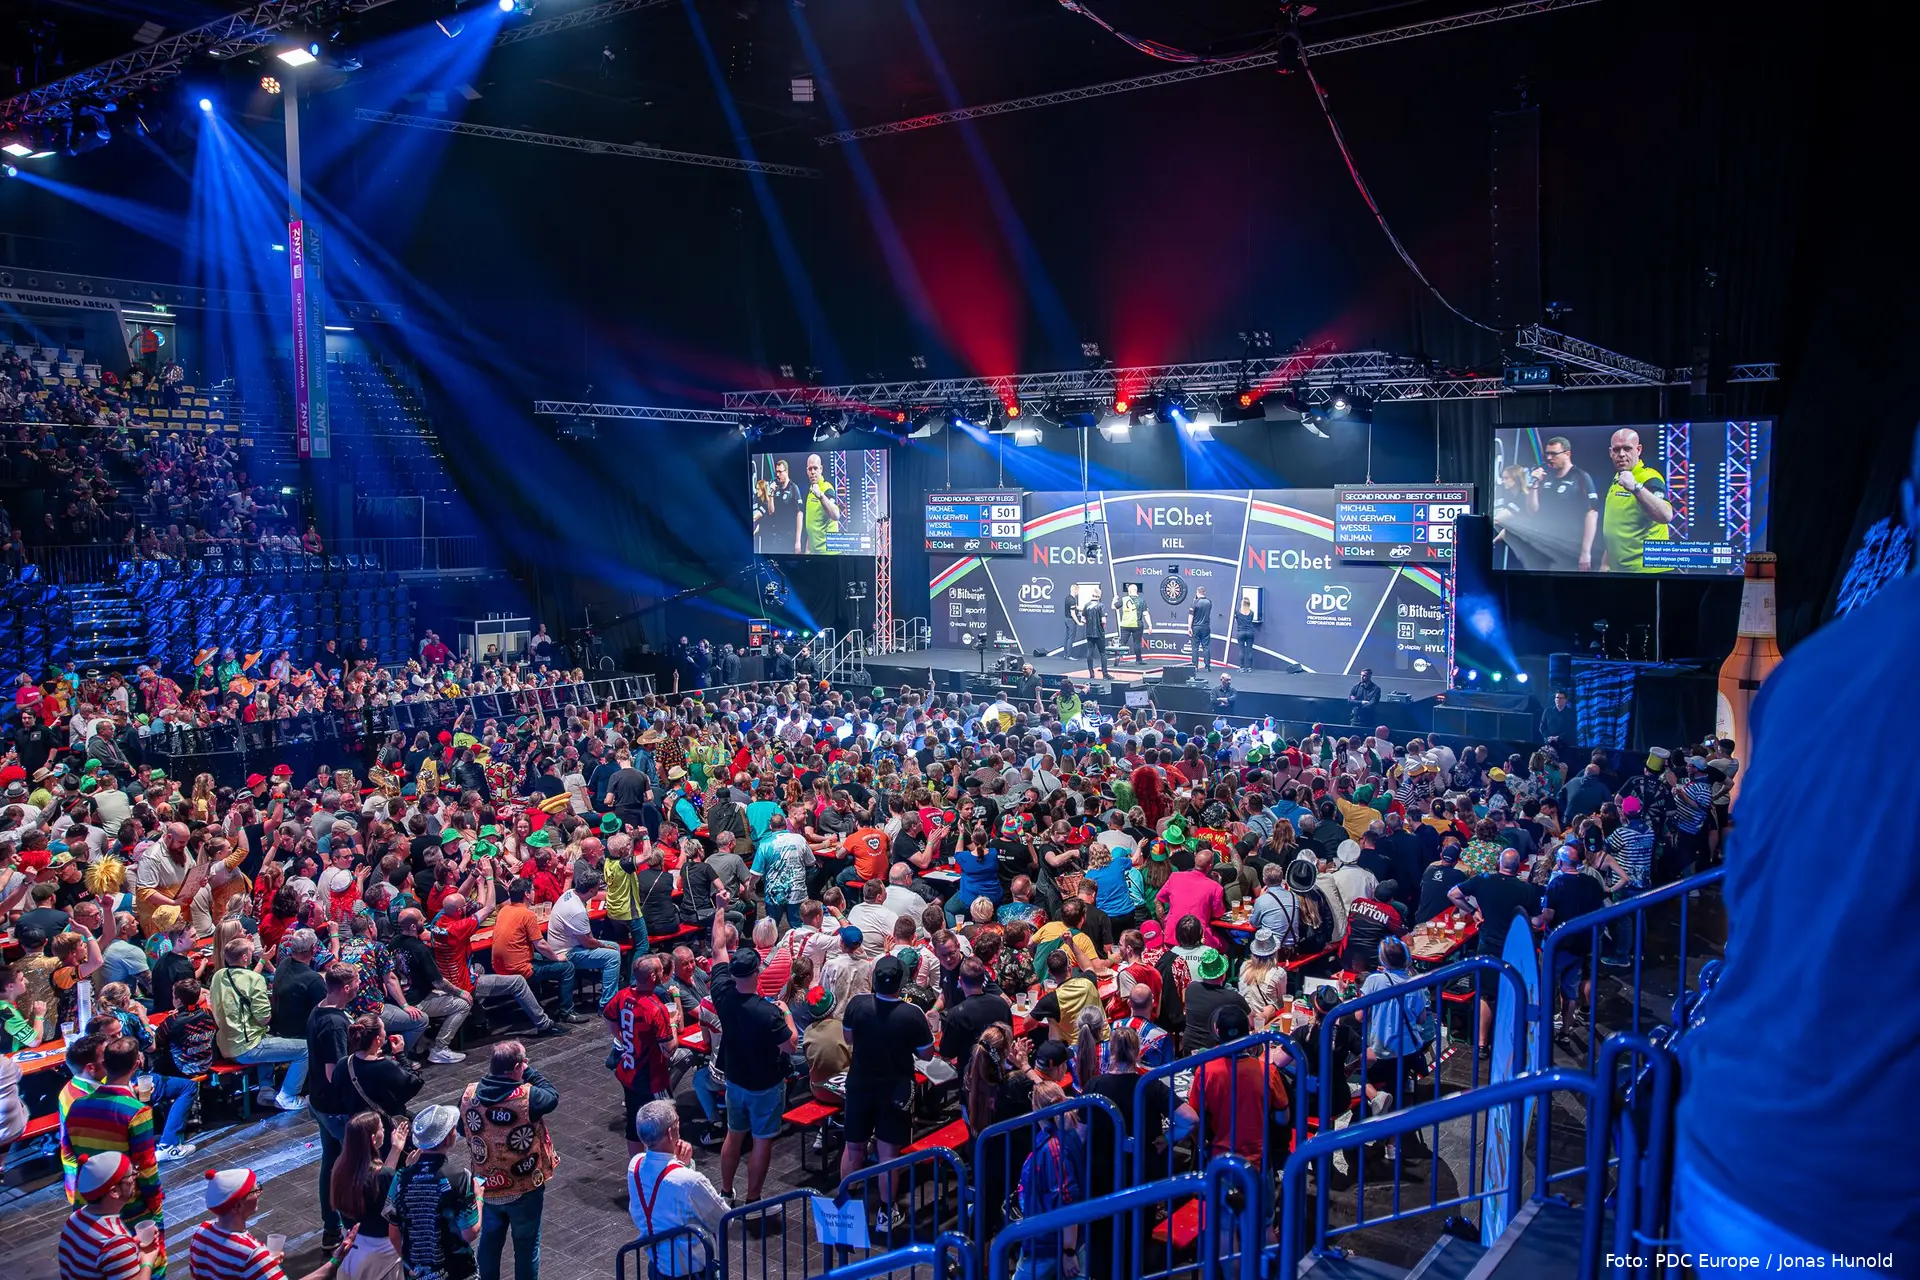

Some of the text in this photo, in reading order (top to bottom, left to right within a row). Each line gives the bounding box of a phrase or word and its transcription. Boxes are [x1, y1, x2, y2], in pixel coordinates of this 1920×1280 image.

[294, 227, 302, 261] JANZ
[17, 293, 81, 307] WUNDERINO
[82, 301, 115, 310] ARENA
[296, 292, 305, 388] www.moebel-janz.de
[316, 402, 326, 435] JANZ
[982, 508, 989, 518] 4
[997, 508, 1016, 518] 501
[1416, 508, 1425, 519] 4
[983, 525, 989, 535] 2
[998, 525, 1016, 534] 501
[1416, 528, 1425, 540] 2
[1437, 529, 1452, 539] 50
[1162, 538, 1184, 548] KIEL
[957, 588, 985, 601] Bitburger
[1022, 584, 1052, 599] PDC
[1311, 593, 1348, 611] PDC
[1409, 604, 1445, 620] Bitburge
[1419, 628, 1445, 636] sport
[1351, 902, 1389, 924] CLAYTON
[492, 1110, 511, 1121] 180
[517, 1157, 535, 1173] 180
